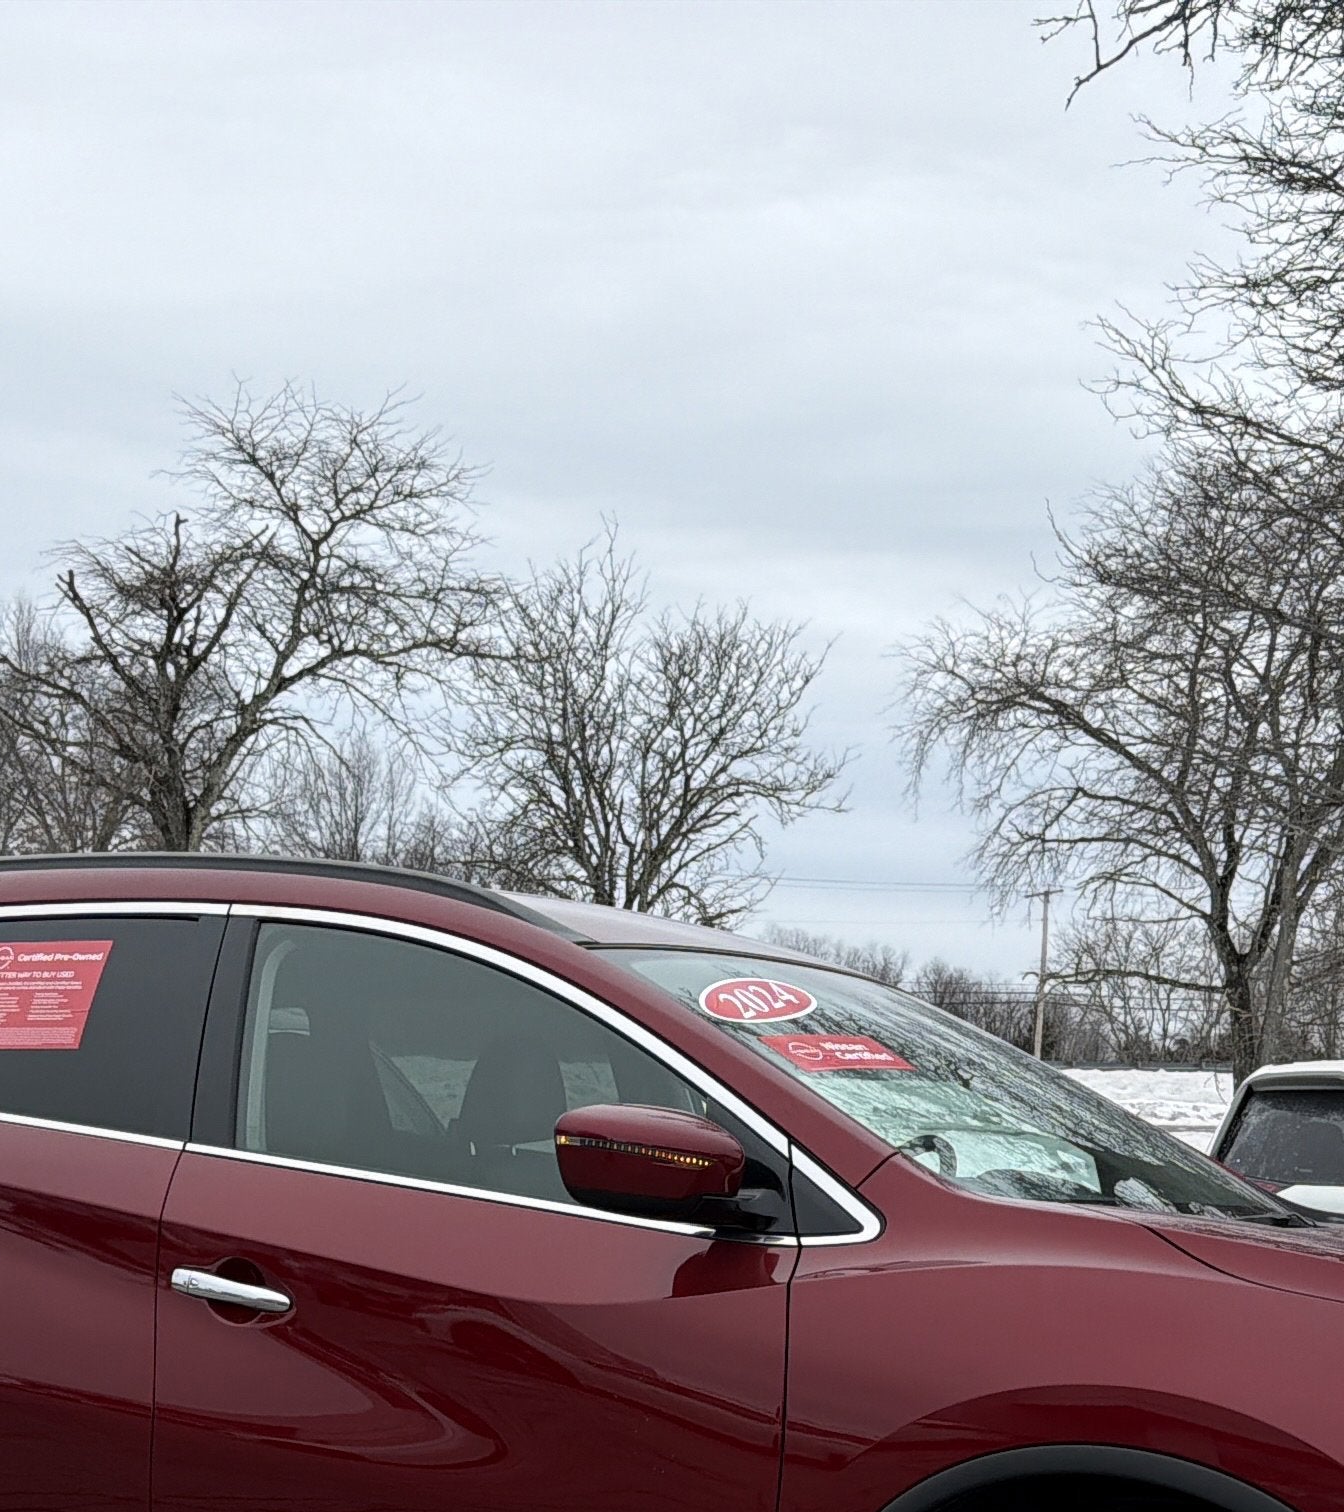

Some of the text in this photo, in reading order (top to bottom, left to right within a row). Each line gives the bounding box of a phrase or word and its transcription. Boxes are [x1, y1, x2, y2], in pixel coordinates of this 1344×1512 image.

[17, 952, 104, 961] Certified Pre-Owned
[718, 981, 800, 1019] 2024
[834, 1051, 895, 1062] Certified
